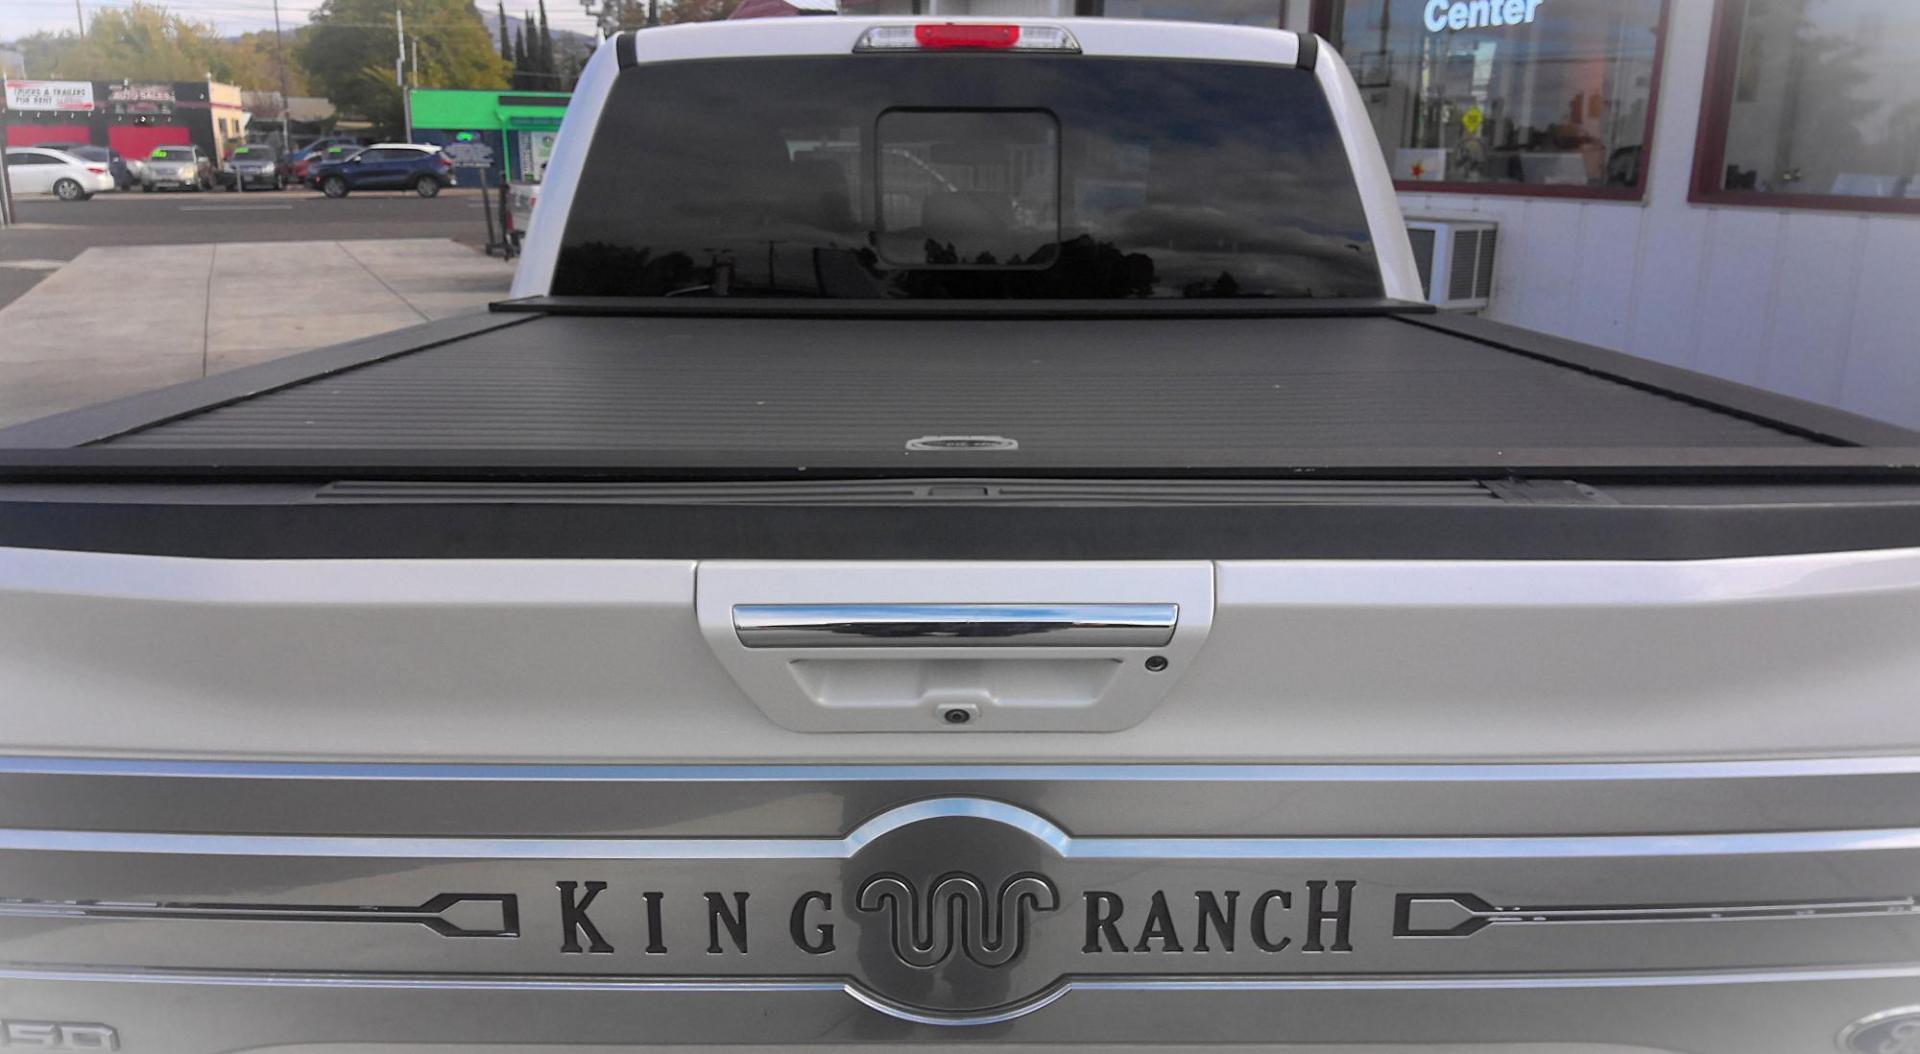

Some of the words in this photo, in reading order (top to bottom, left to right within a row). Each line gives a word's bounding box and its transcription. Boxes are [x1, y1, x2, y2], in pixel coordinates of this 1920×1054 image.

[1424, 0, 1544, 32] Center
[556, 880, 836, 955] KING
[1081, 879, 1357, 954] RANCH
